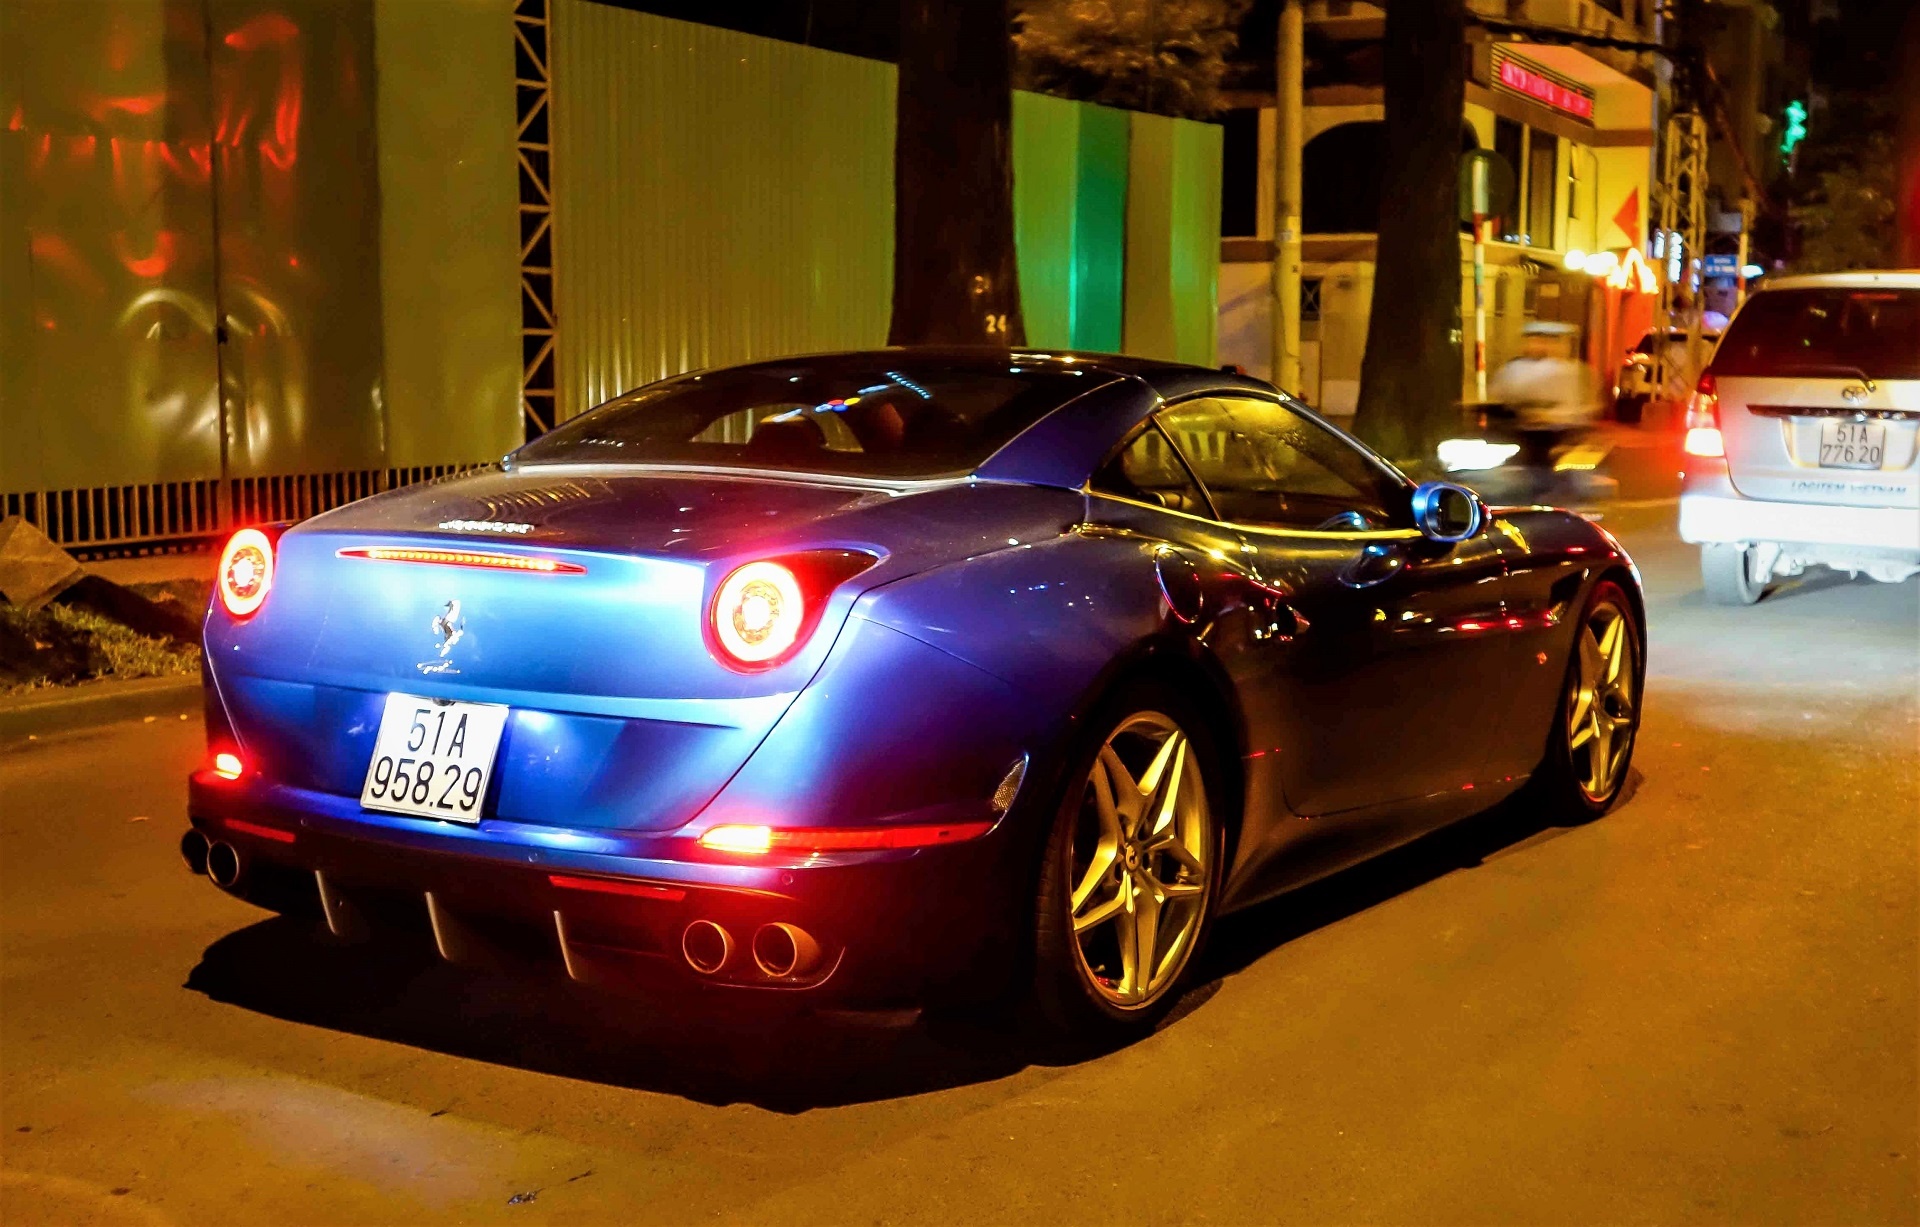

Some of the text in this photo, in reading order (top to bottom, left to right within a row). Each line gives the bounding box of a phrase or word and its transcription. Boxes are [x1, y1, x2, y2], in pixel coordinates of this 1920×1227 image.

[1837, 424, 1868, 443] 51A
[1822, 444, 1880, 463] 77620
[407, 708, 468, 758] 51A
[370, 755, 483, 811] 958.29
